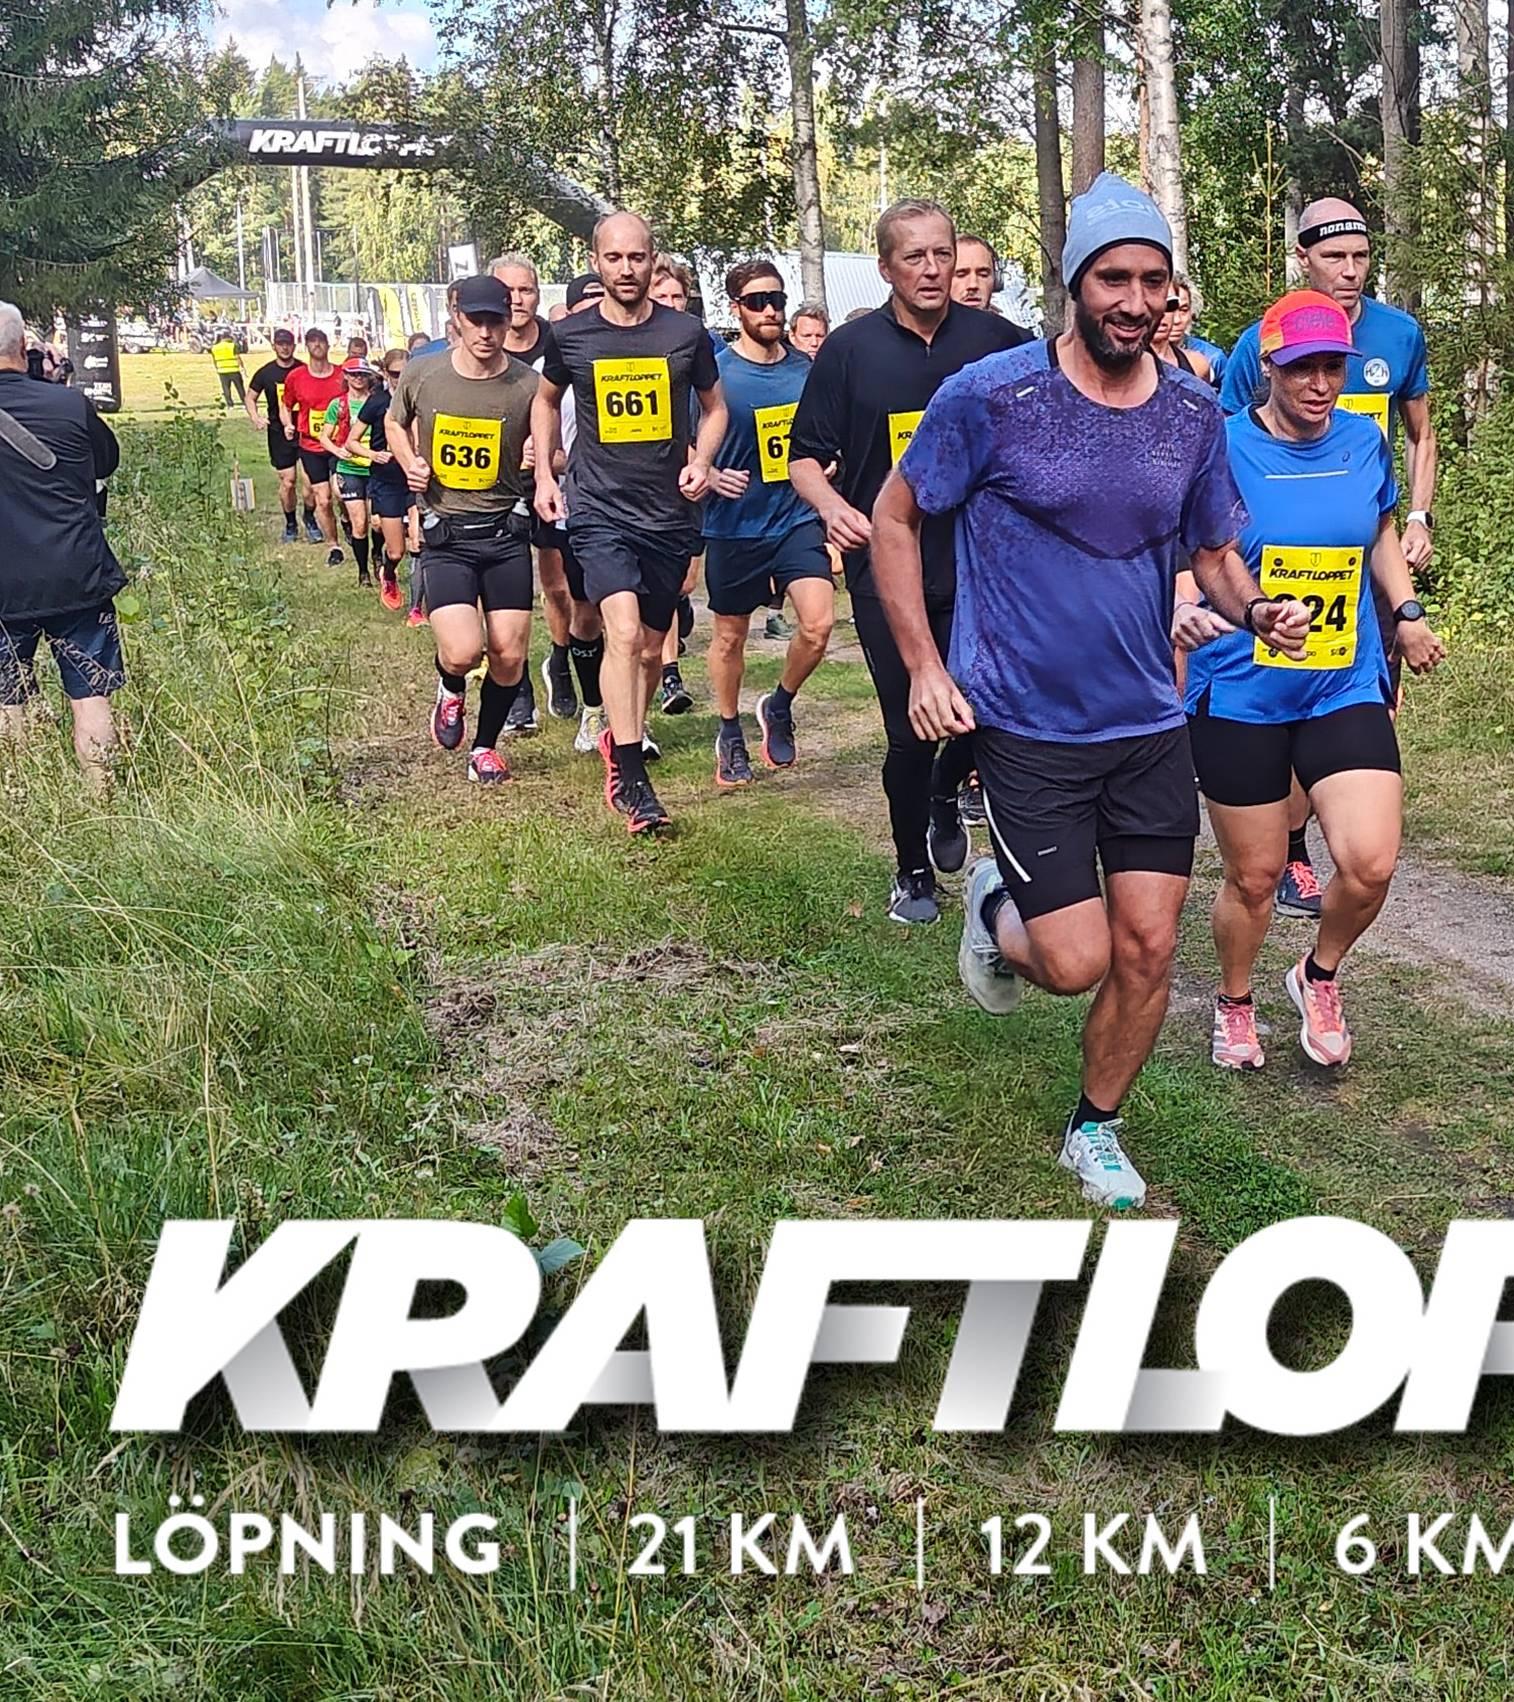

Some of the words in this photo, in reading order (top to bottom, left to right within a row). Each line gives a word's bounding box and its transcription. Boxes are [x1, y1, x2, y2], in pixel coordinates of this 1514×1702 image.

[605, 390, 659, 417] 661
[440, 443, 492, 470] 636
[1269, 568, 1355, 581] KRAFTLOPPET
[1272, 593, 1348, 633] 24
